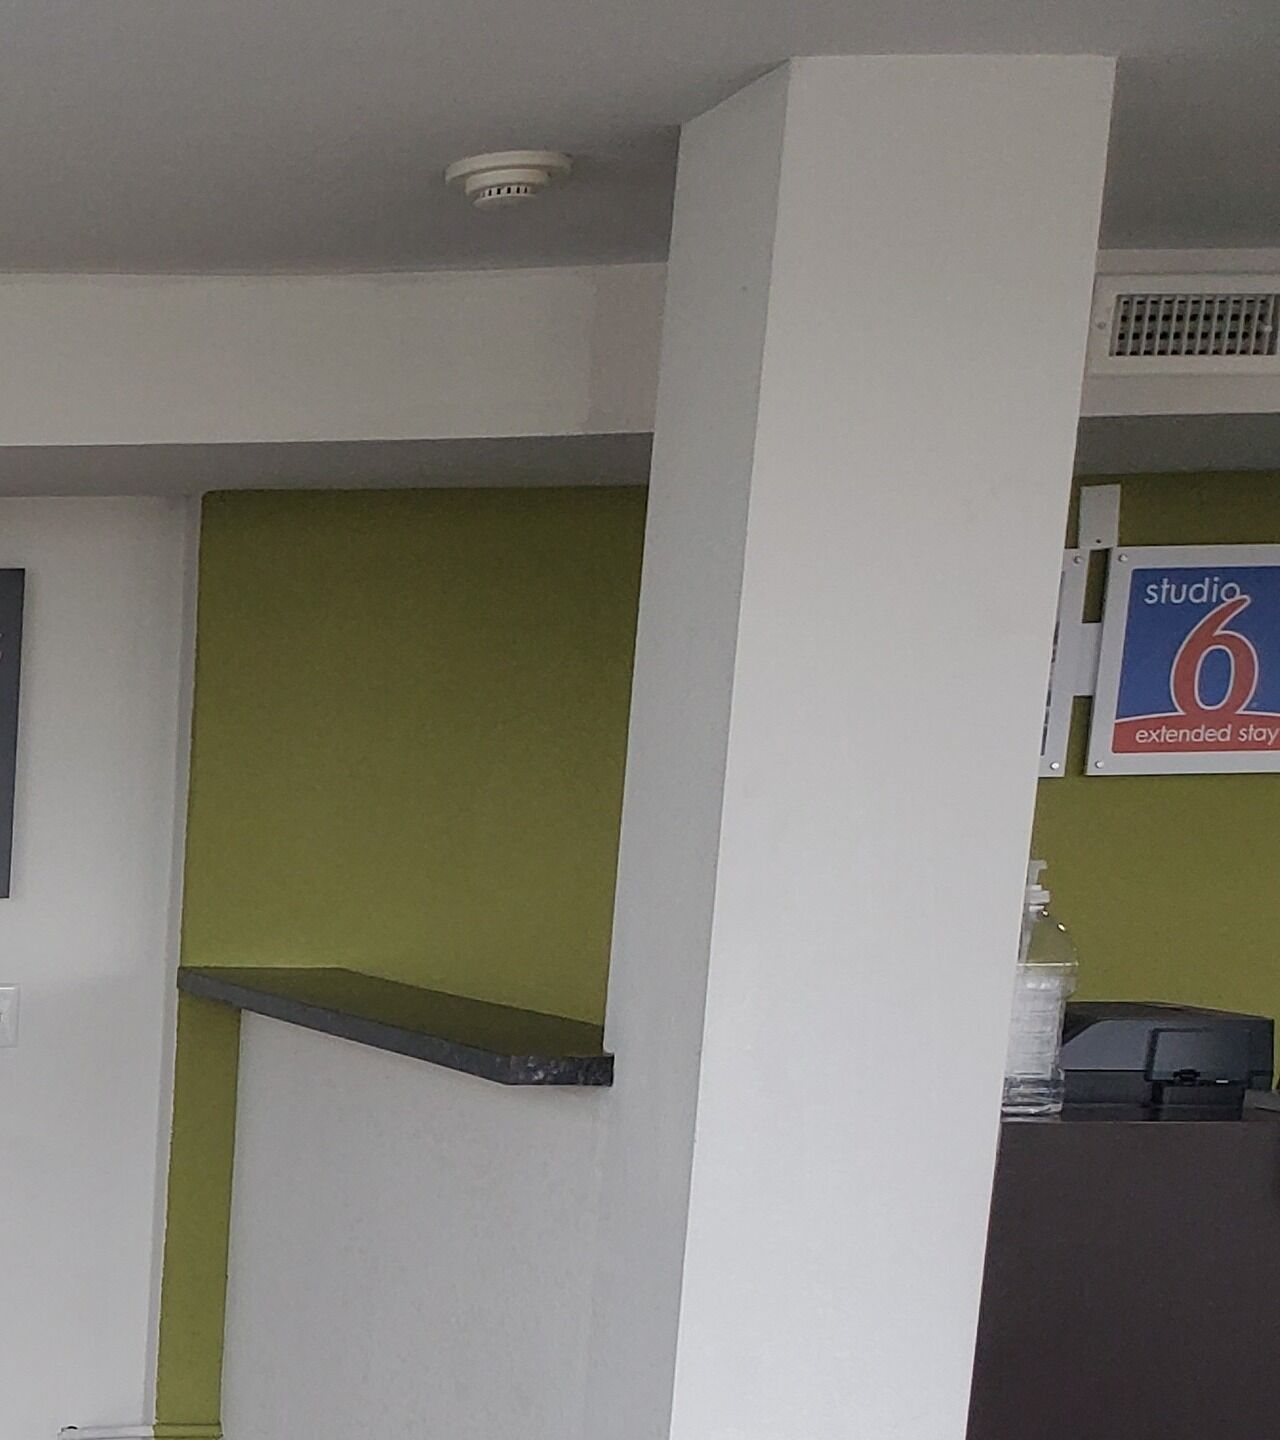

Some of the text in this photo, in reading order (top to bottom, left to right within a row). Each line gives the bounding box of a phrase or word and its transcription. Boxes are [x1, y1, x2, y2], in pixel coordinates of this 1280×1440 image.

[1143, 577, 1241, 605] studio
[1170, 594, 1260, 715] 6
[1135, 723, 1280, 747] extended stay
